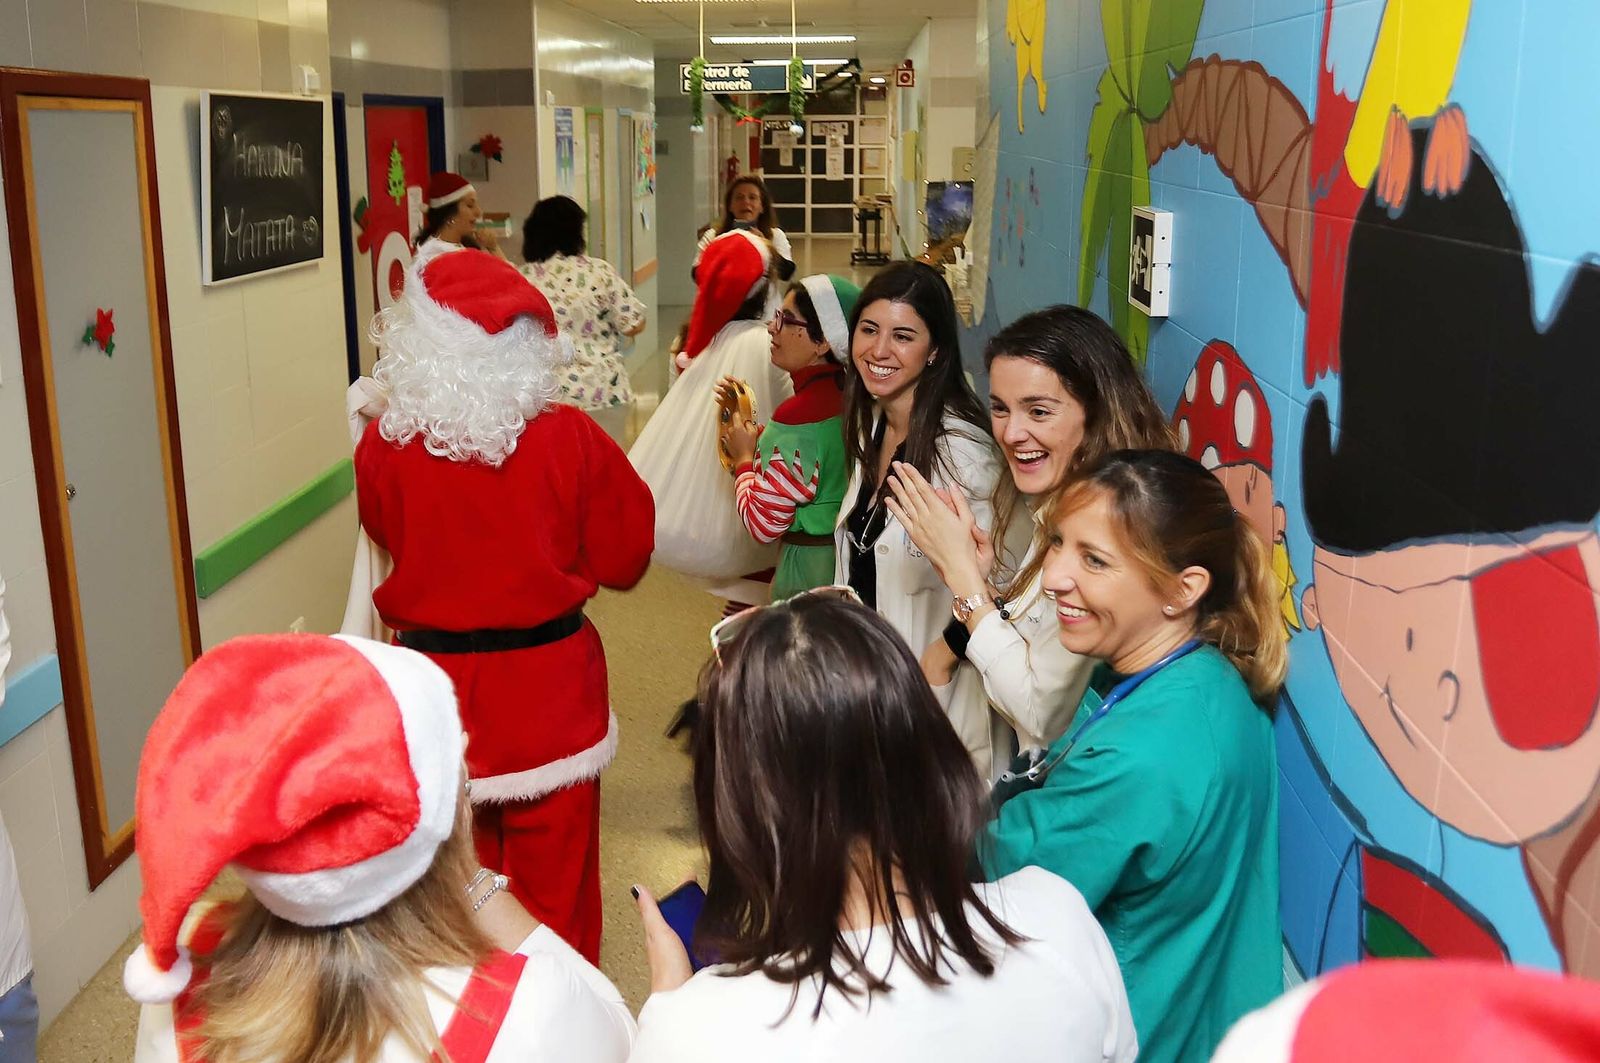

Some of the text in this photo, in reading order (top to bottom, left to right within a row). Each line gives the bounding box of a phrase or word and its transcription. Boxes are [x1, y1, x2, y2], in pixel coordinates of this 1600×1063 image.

[683, 65, 750, 78] Cntrol de
[684, 78, 752, 91] Efermería
[233, 133, 304, 178] HAKUNA
[223, 206, 296, 264] MATATA
